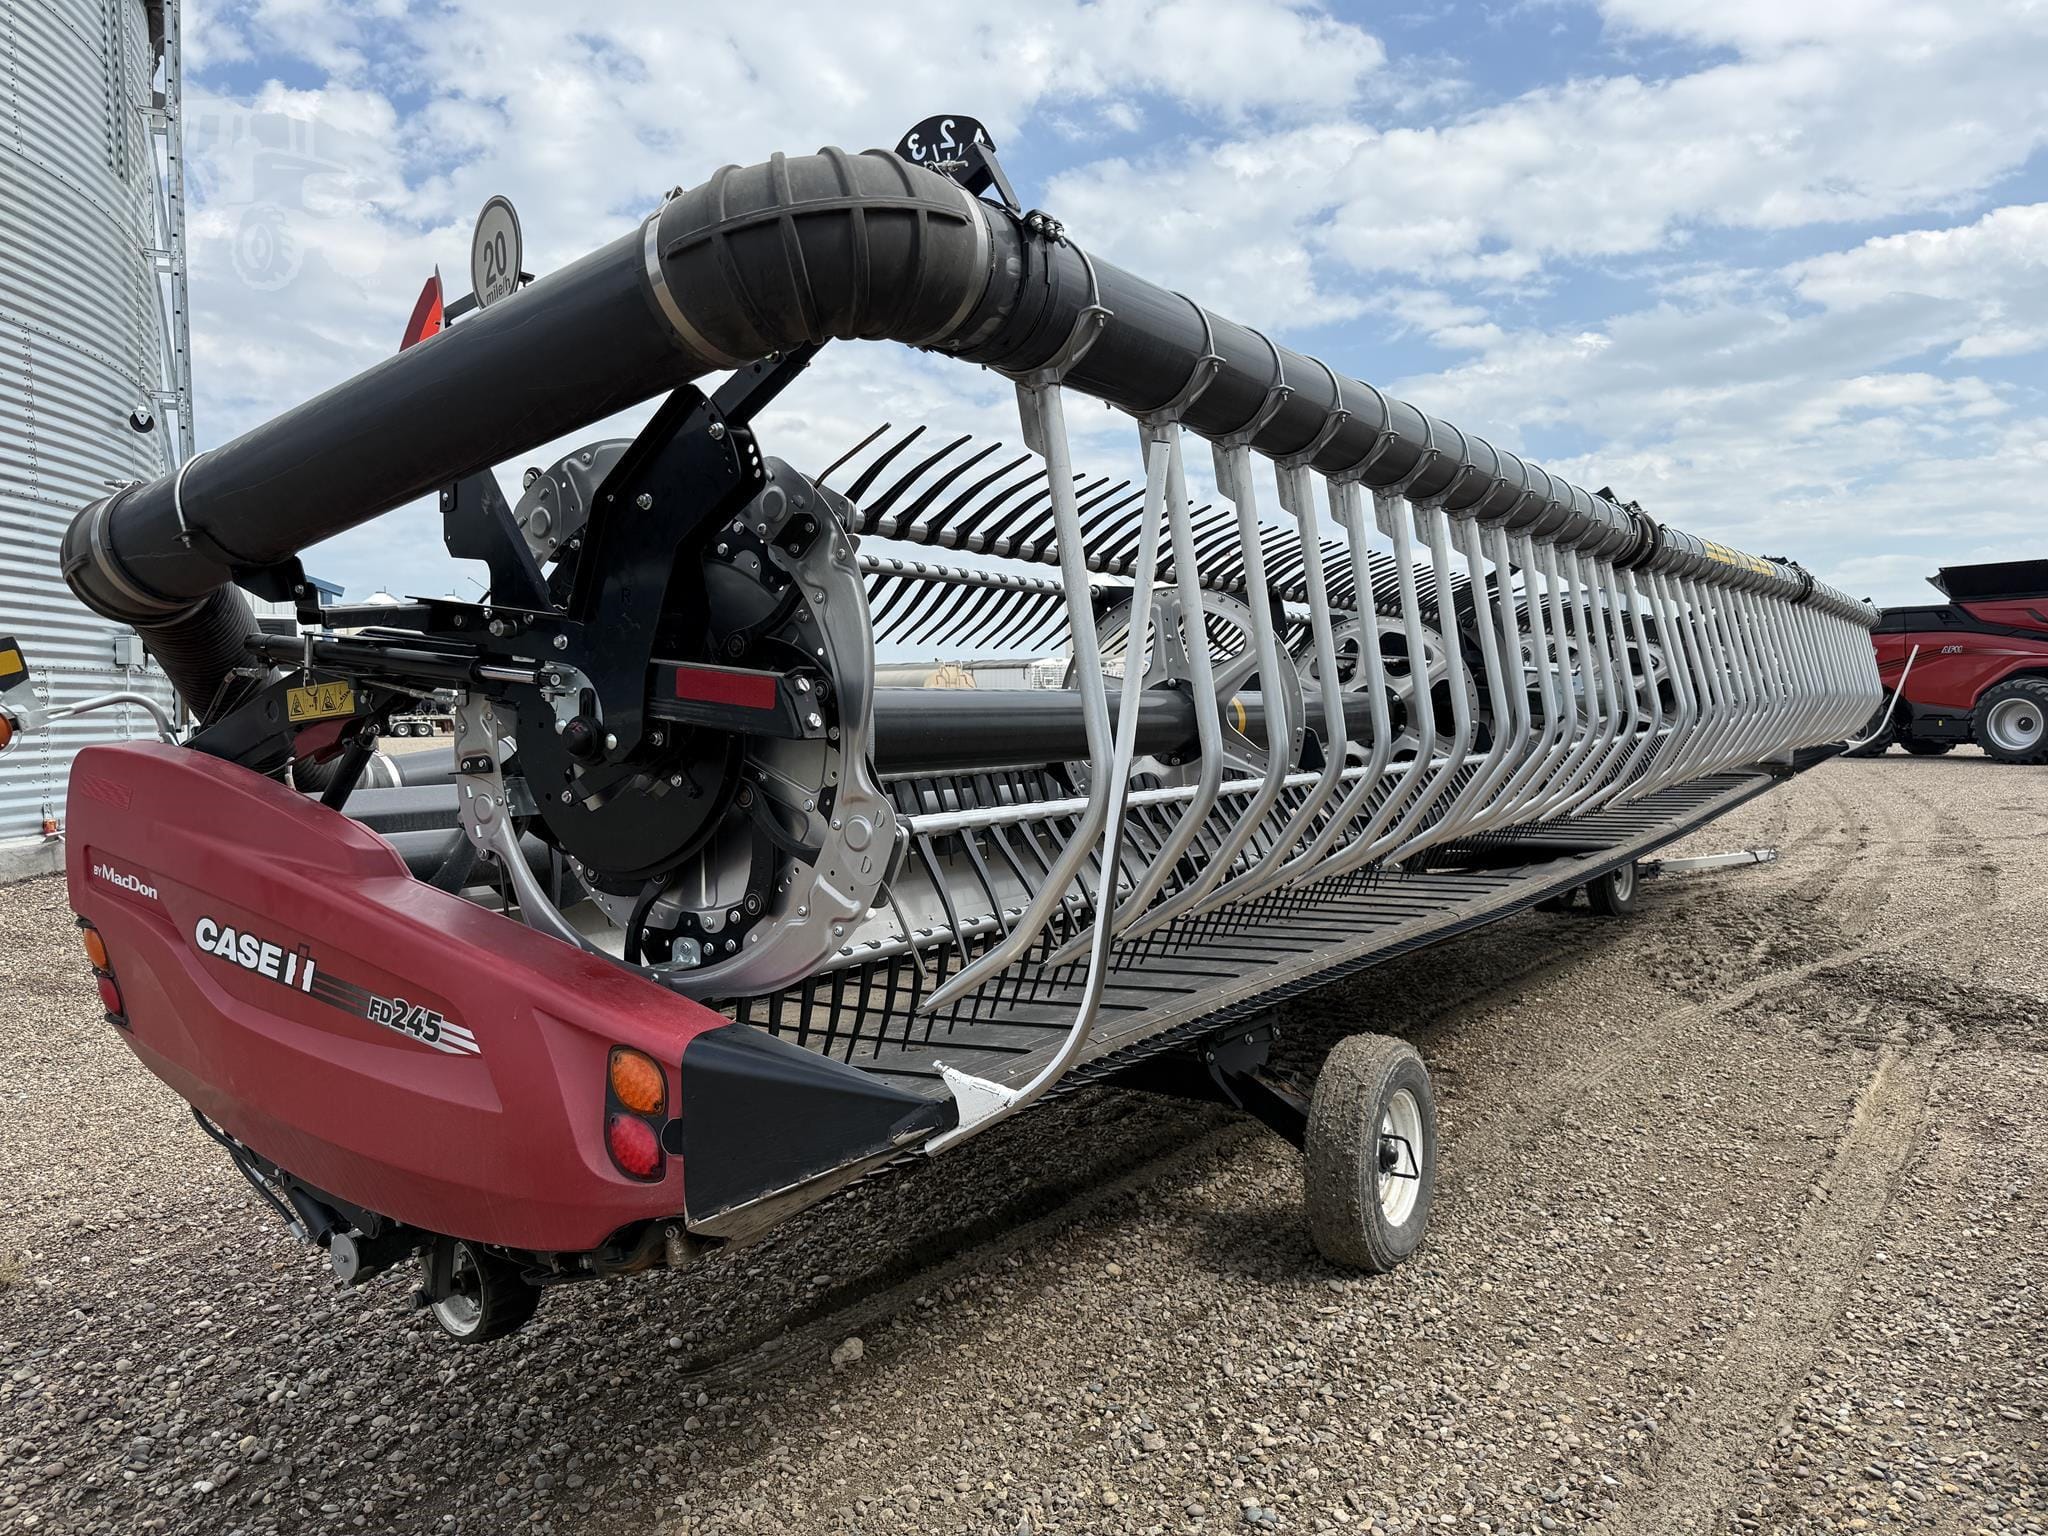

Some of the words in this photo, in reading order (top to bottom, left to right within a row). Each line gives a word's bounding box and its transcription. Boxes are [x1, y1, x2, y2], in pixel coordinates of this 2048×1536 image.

[484, 230, 507, 288] 20
[486, 276, 511, 306] mile/h
[93, 864, 101, 877] BY
[102, 863, 158, 900] MacDon
[195, 917, 283, 979] CASE
[367, 996, 444, 1044] FD245
